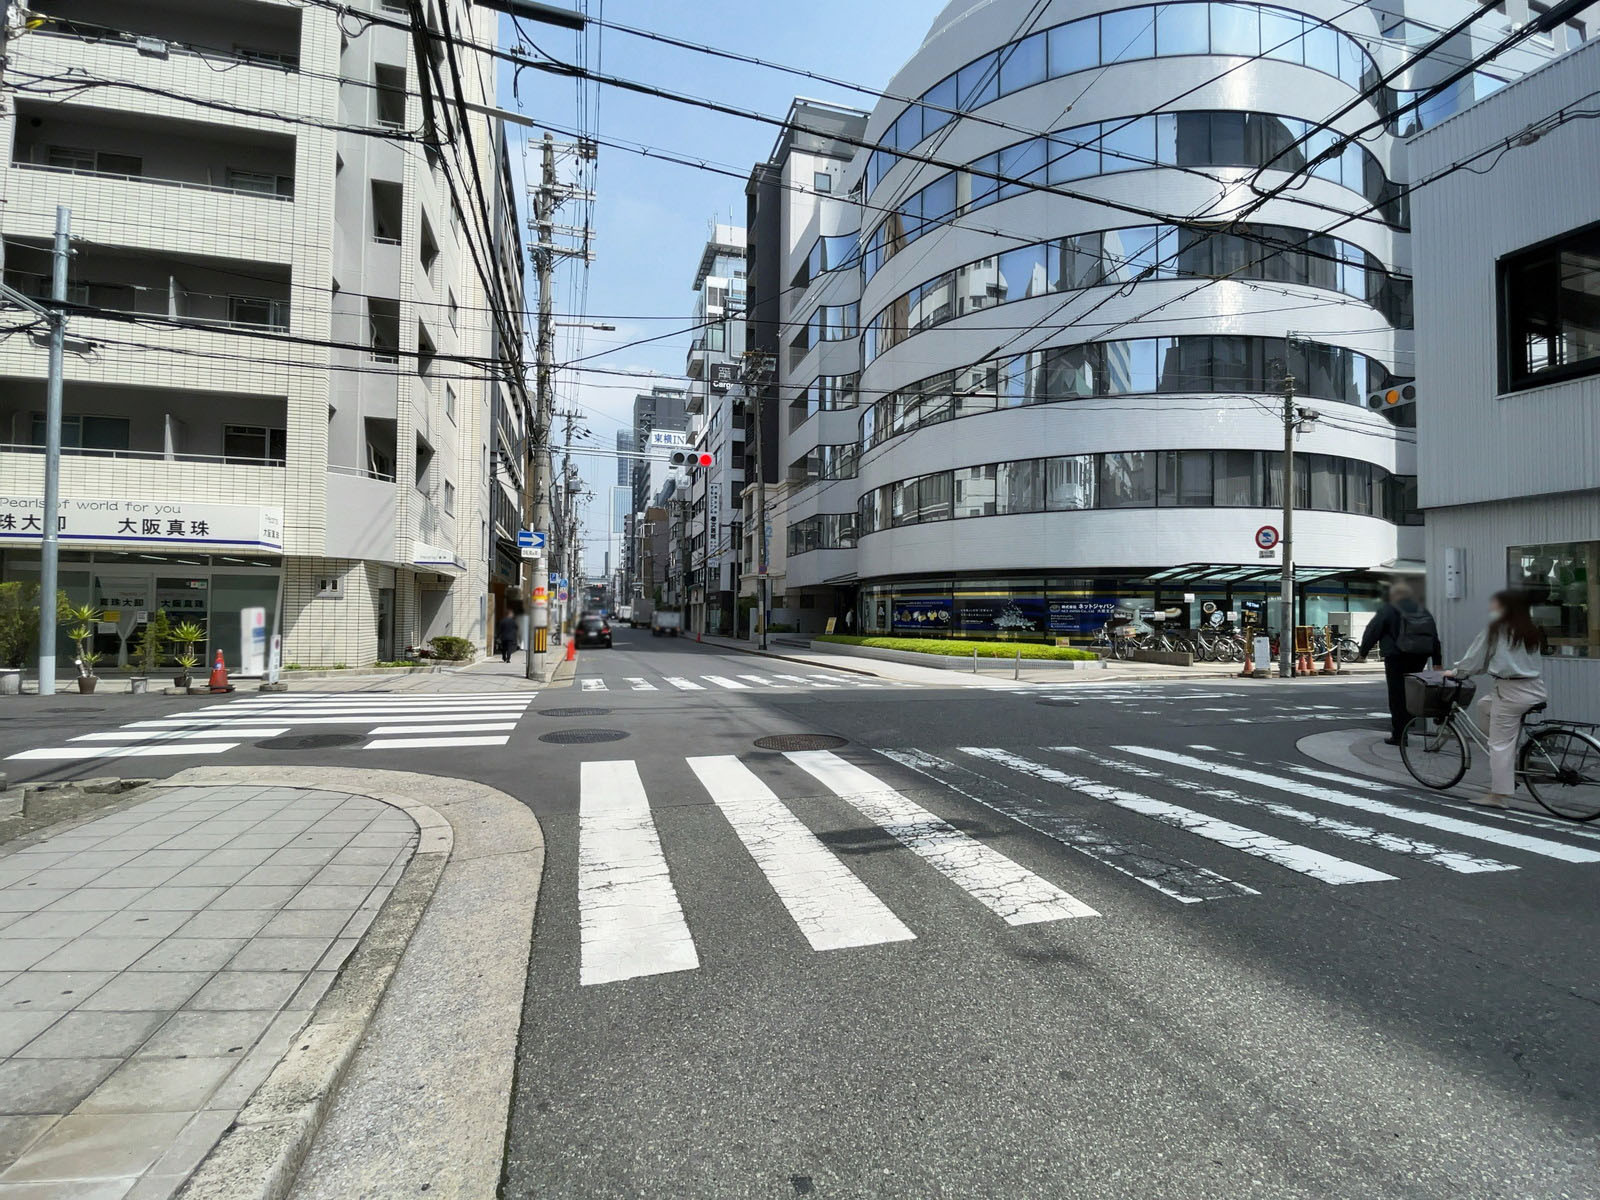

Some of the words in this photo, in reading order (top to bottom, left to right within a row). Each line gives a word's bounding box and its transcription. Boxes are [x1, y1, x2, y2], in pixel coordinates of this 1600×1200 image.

[76, 501, 119, 511] world
[125, 502, 149, 512] for
[154, 505, 182, 515] you
[117, 517, 209, 536] 大阪真珠
